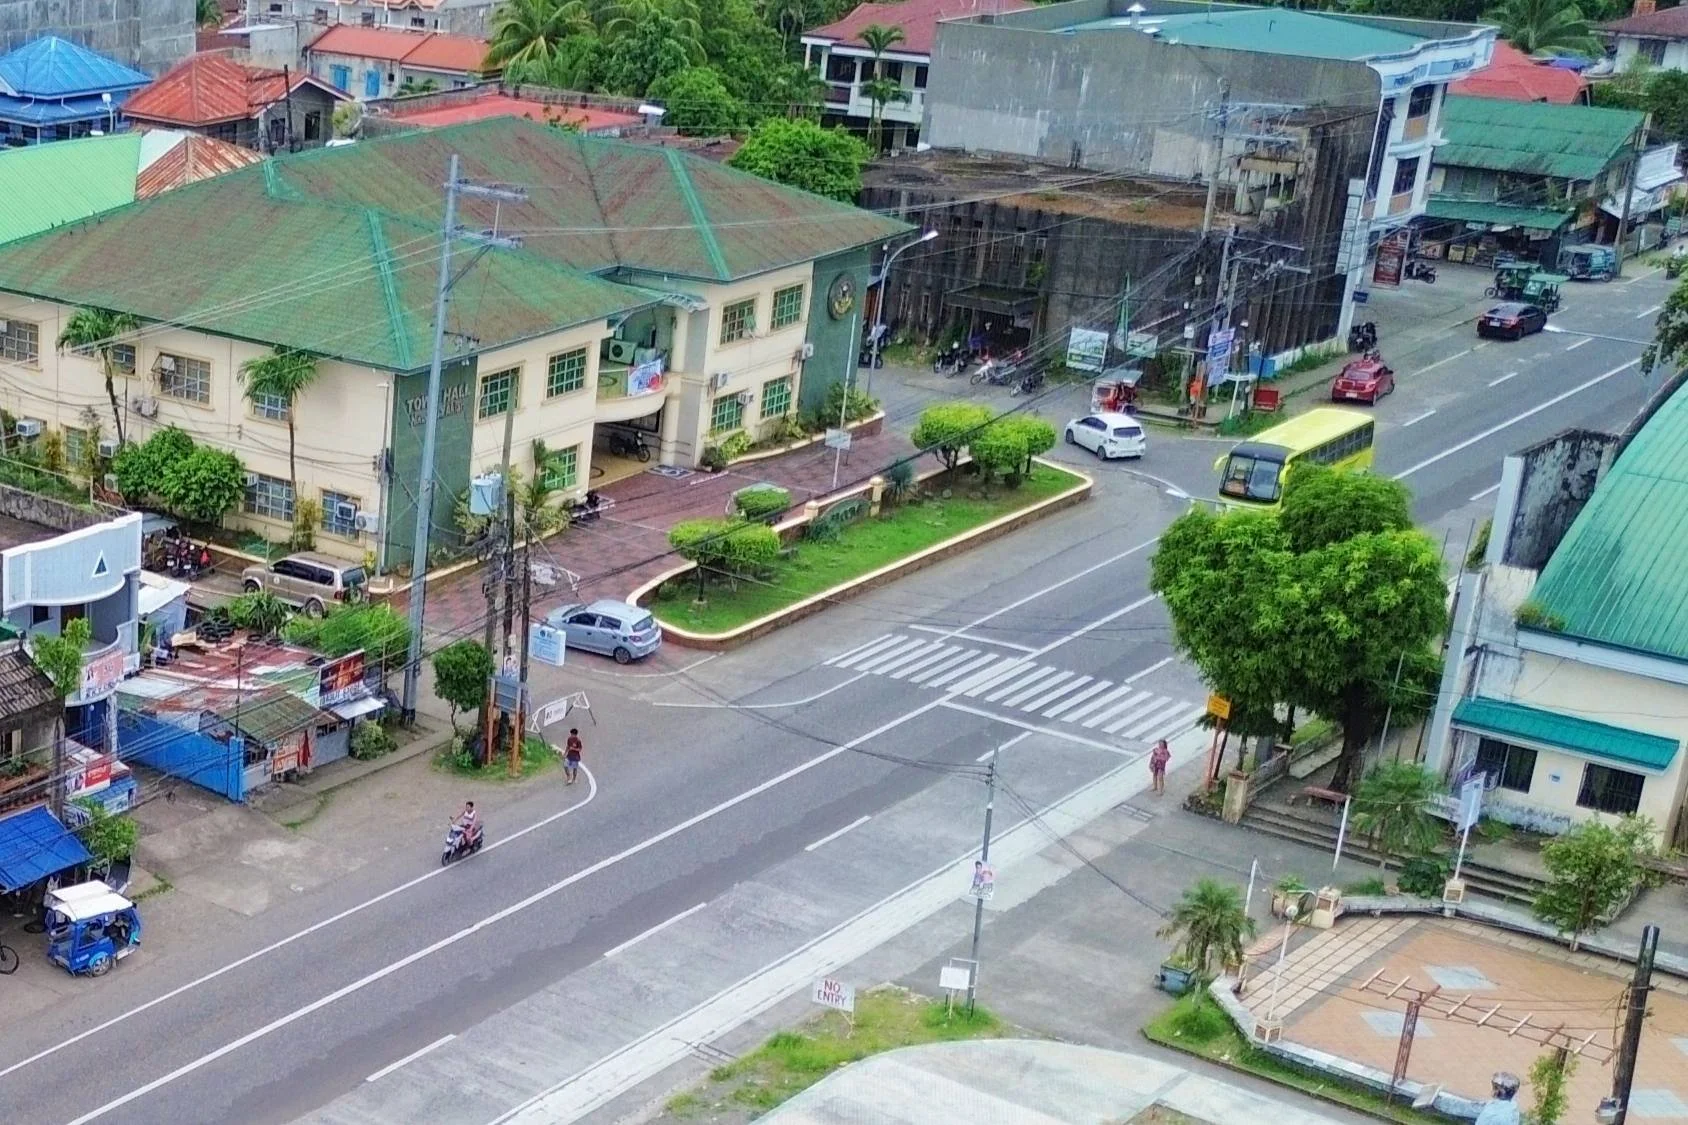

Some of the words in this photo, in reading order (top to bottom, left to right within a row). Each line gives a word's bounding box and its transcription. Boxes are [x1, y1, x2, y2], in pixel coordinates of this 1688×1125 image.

[406, 394, 431, 413] TOW
[443, 383, 470, 404] HALL
[824, 979, 841, 993] NO
[817, 989, 847, 1006] ENTRY
